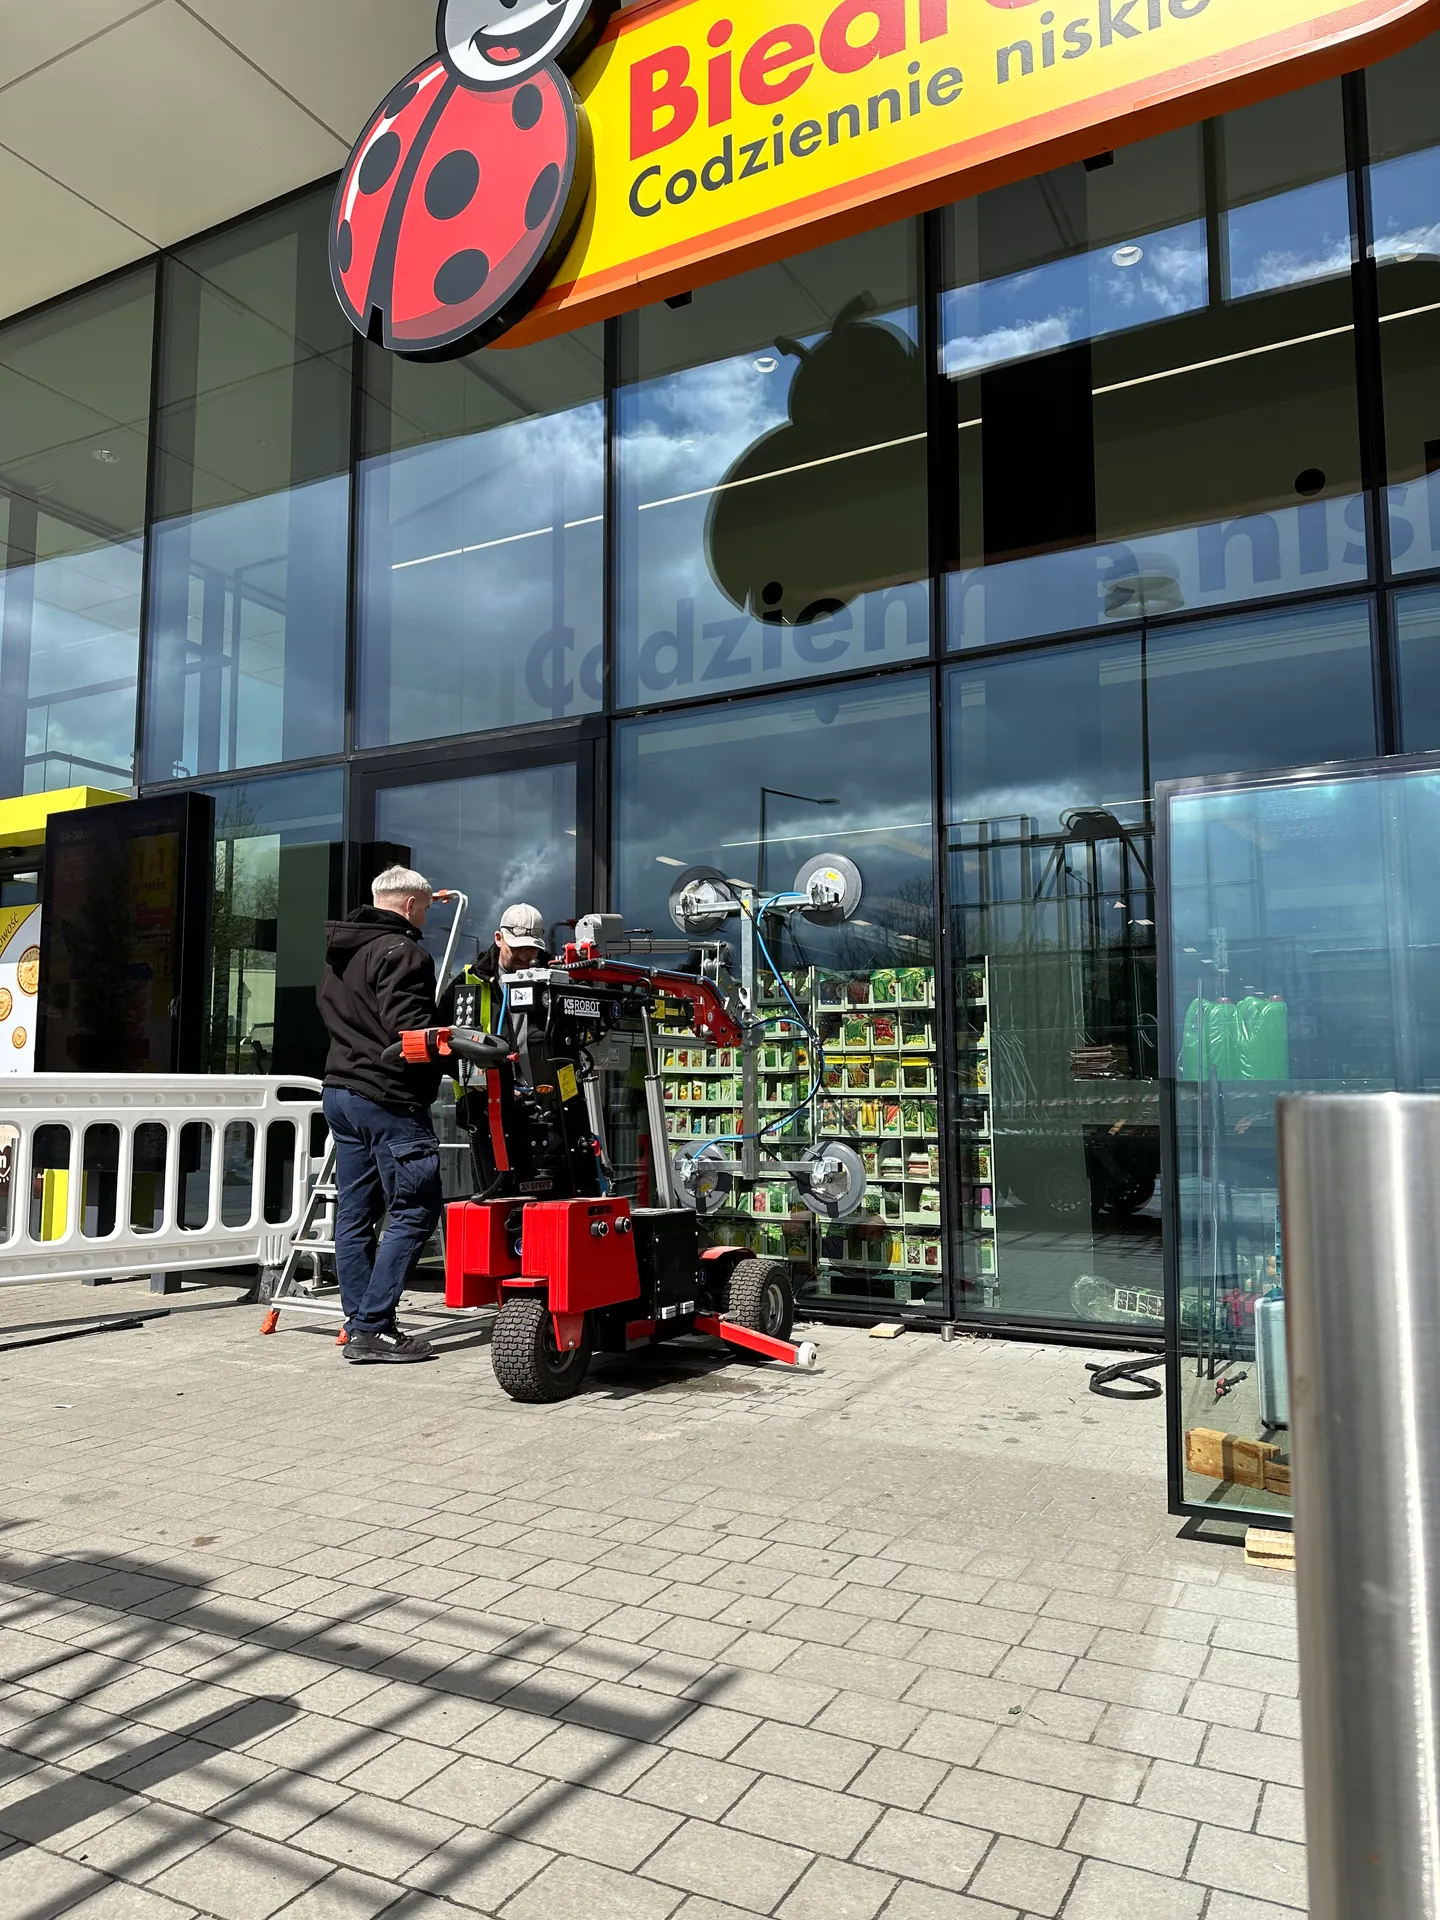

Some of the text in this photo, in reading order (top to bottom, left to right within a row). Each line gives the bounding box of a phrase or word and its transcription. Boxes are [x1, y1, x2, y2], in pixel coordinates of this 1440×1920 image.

[628, 60, 964, 218] Codziennie
[630, 0, 1044, 162] Bied
[564, 998, 601, 1012] KS ROBOT
